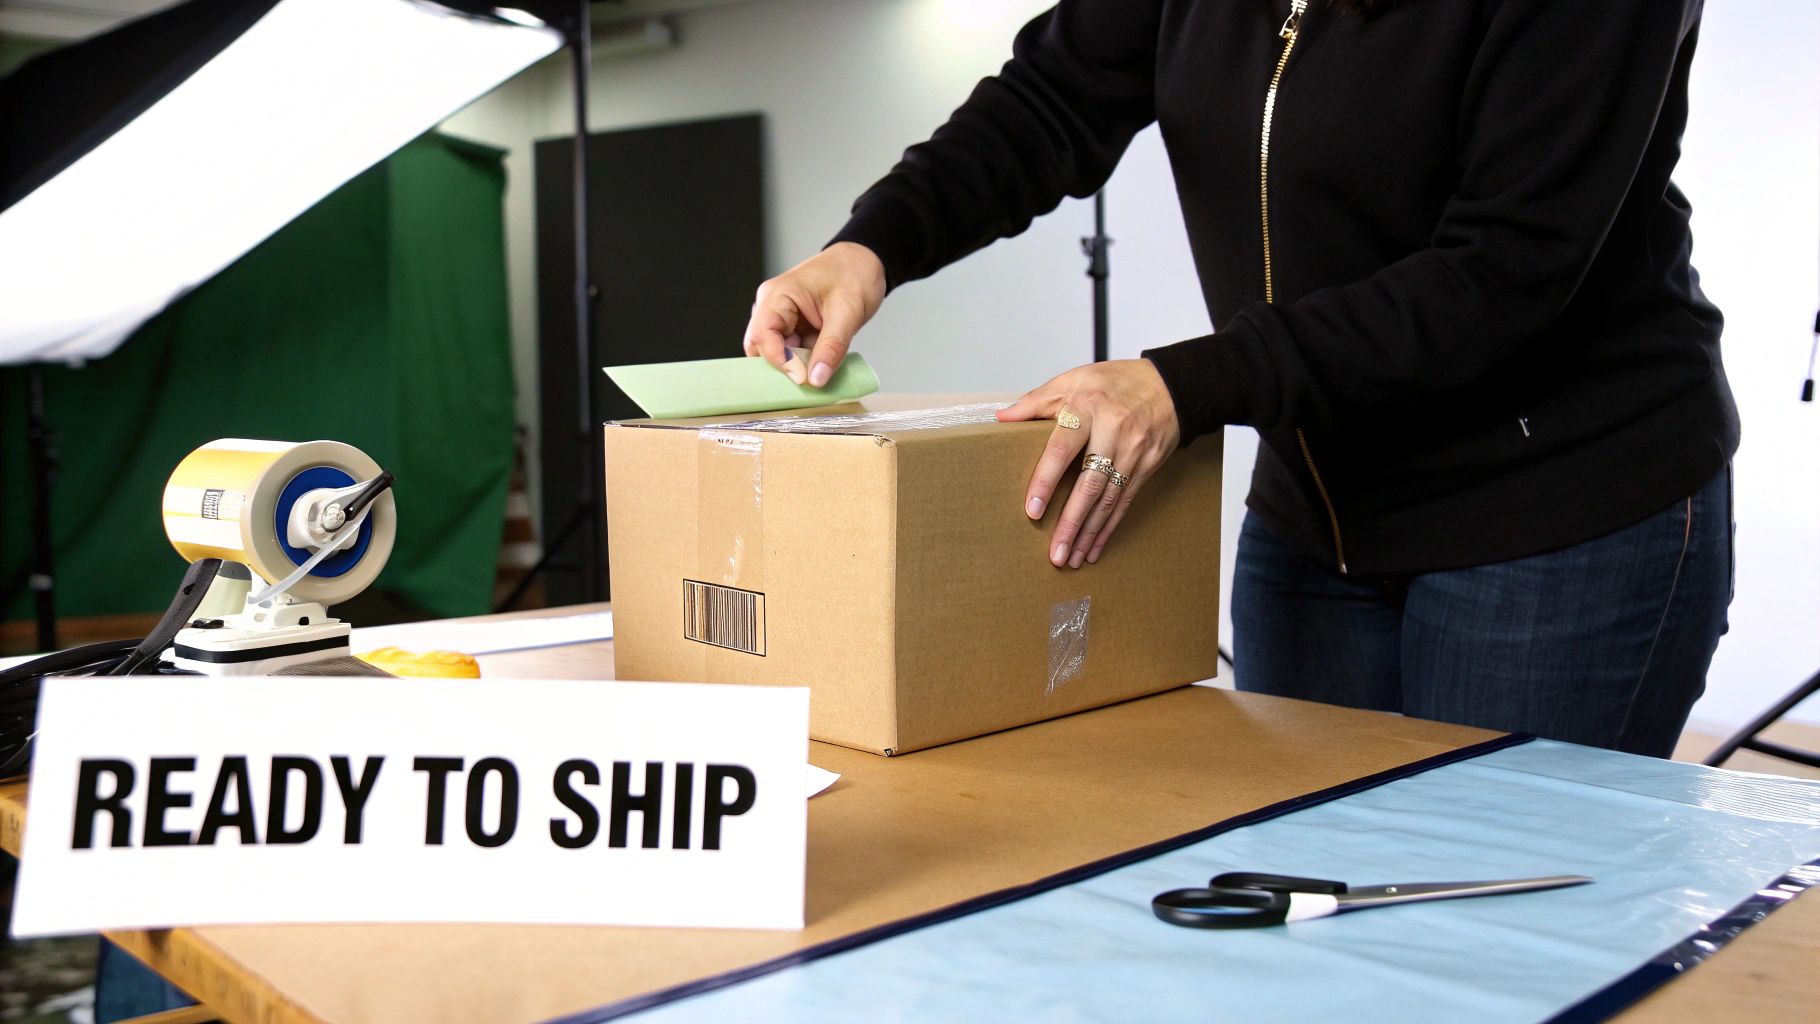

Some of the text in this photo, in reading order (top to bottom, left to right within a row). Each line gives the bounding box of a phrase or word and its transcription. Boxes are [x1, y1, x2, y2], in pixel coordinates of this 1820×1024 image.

[70, 756, 758, 851] READY TO SHIP
